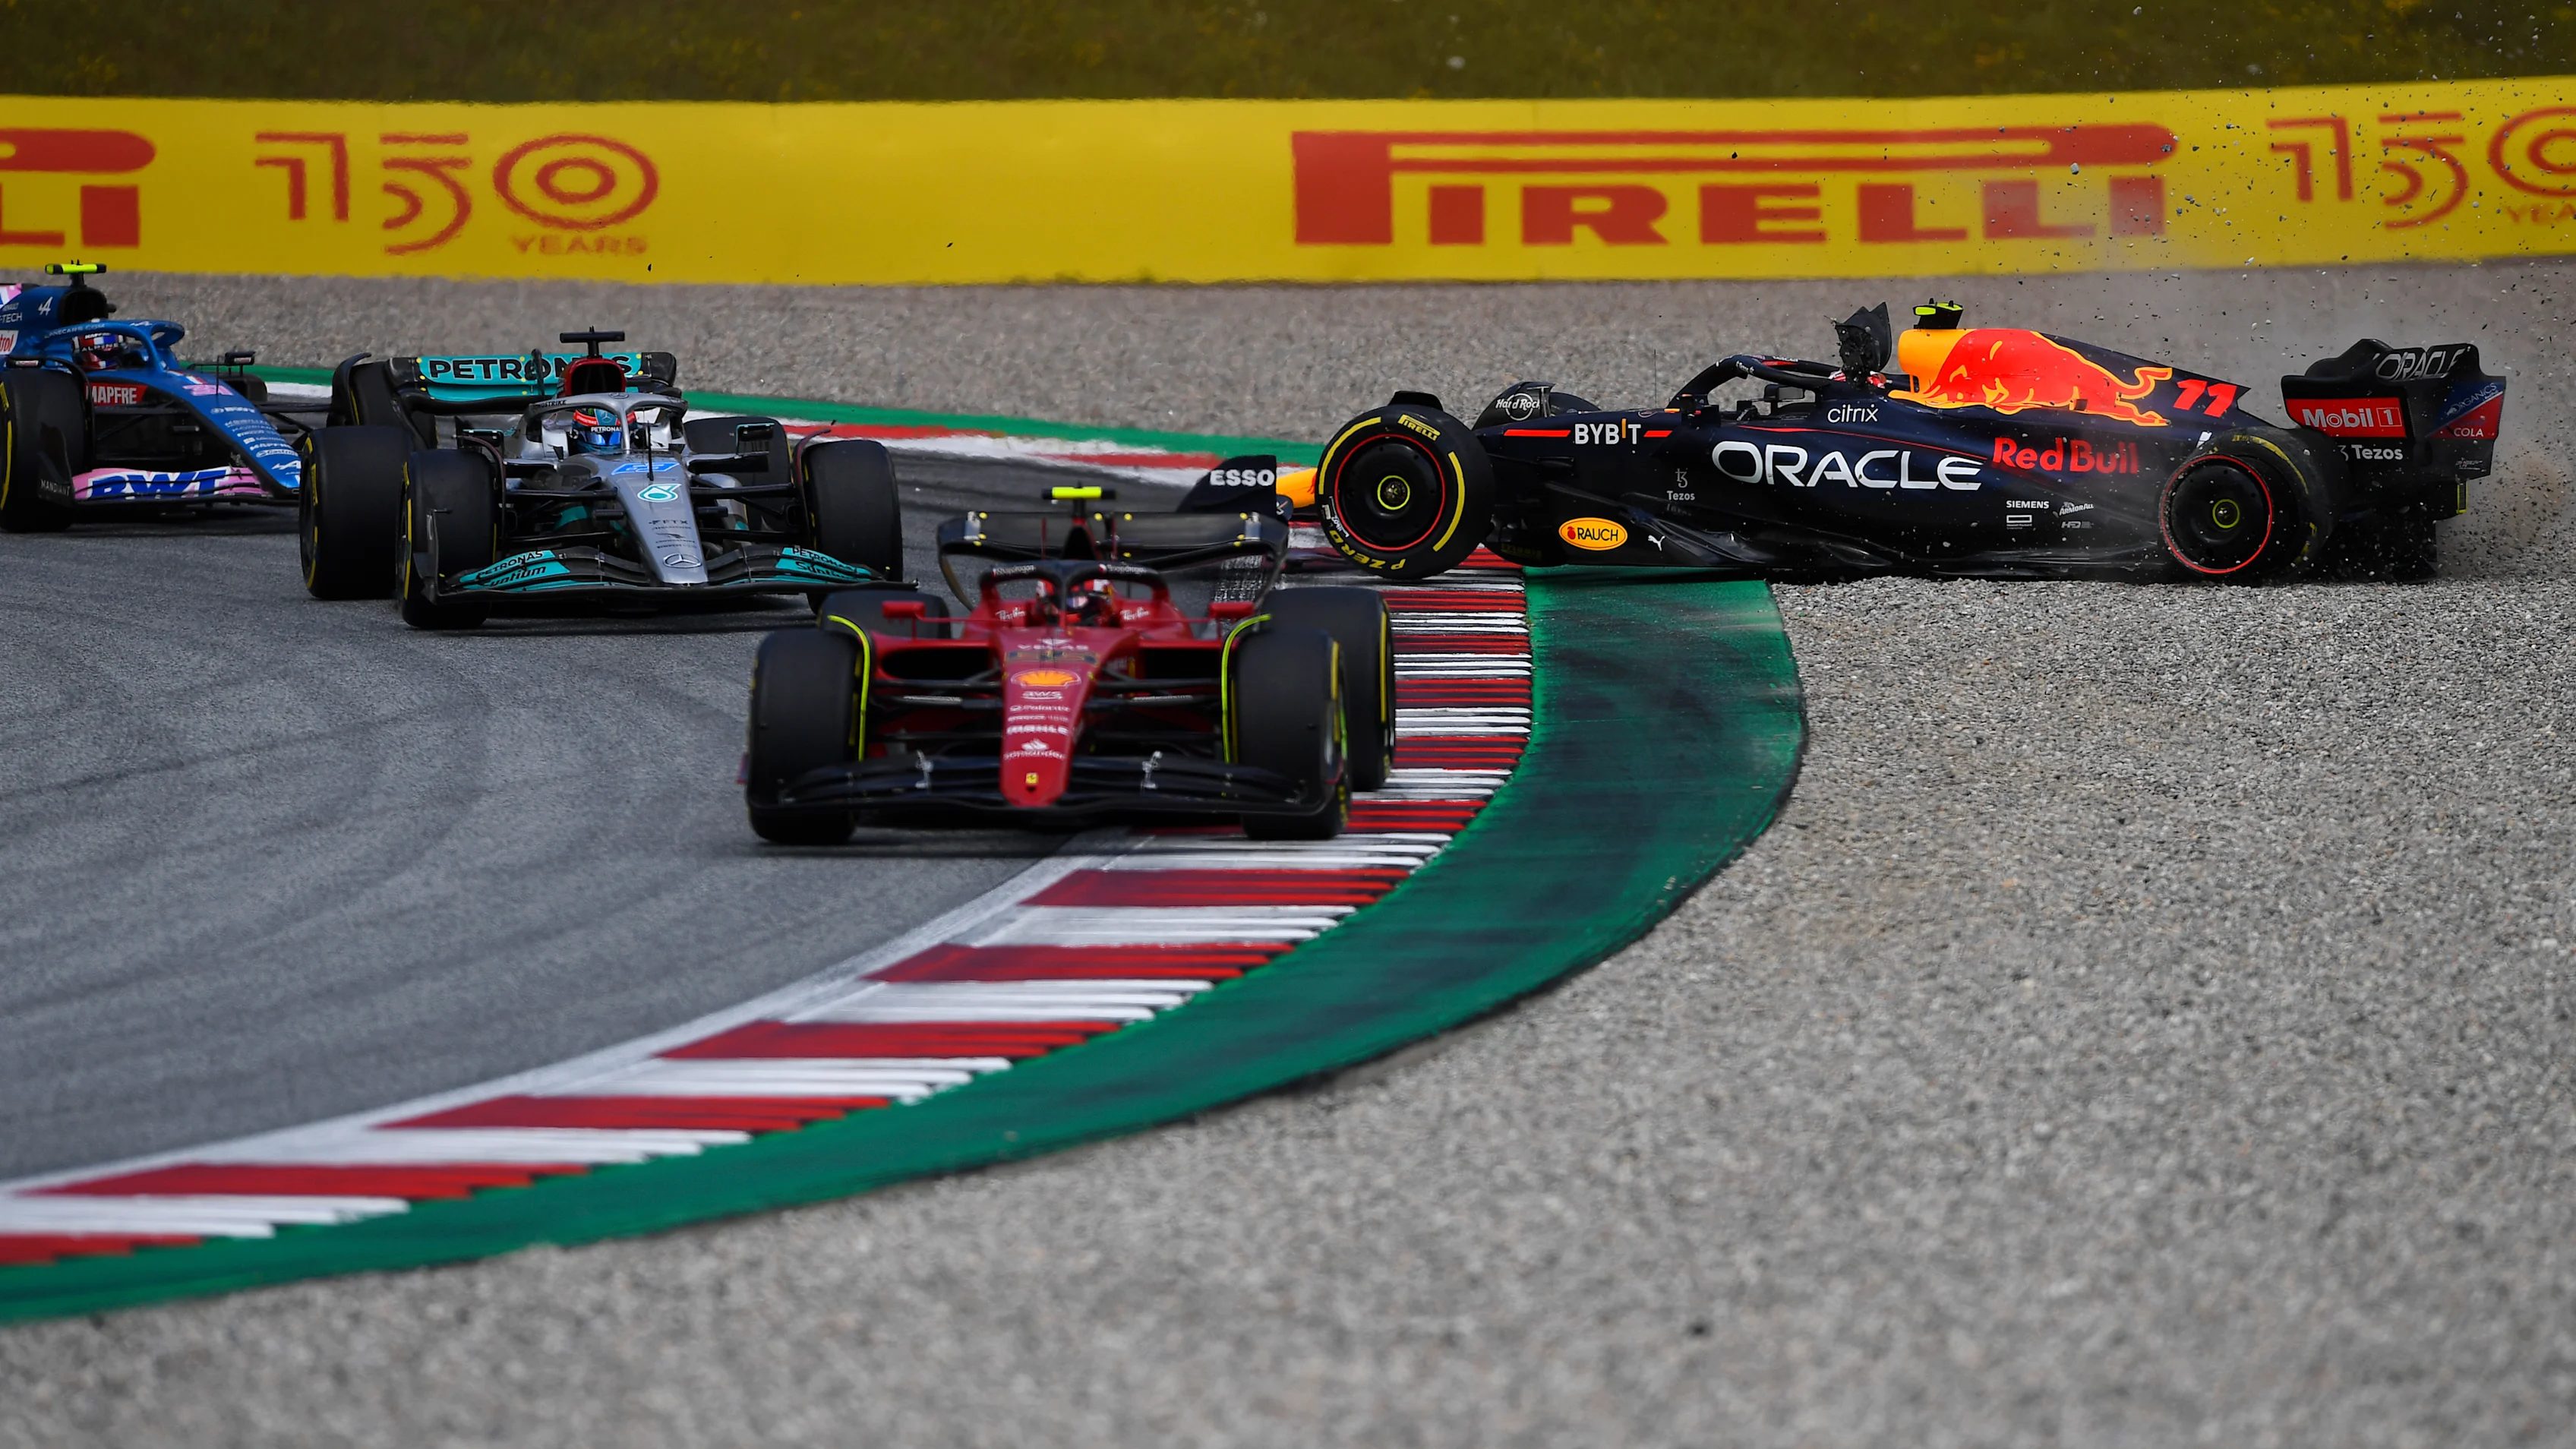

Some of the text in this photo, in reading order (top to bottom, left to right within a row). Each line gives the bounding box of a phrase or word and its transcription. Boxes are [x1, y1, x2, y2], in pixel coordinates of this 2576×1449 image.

[255, 132, 658, 255] 150
[1292, 122, 2177, 245] PIRELLI
[510, 235, 648, 256] YEARS
[428, 355, 633, 380] PETRONS
[2376, 348, 2467, 380] ORACLE
[1495, 398, 1540, 411] Hard Rock
[2173, 378, 2238, 418] 11
[1827, 404, 1880, 423] citrix
[2302, 408, 2374, 428] Mobil
[1397, 414, 1441, 442] PIRELLI
[1574, 418, 1642, 445] BYBIT
[2453, 428, 2484, 437] COLA
[1992, 436, 2139, 475] Red Bull
[2351, 444, 2404, 460] Tezos
[1712, 440, 1984, 491] ORACLE
[40, 478, 71, 497] MANDIANT
[86, 466, 231, 500] BWT
[1209, 469, 1276, 488] ESSO
[1666, 490, 1696, 501] Tezos
[2006, 500, 2050, 510] SIEMENS
[1577, 527, 1619, 542] RAUCH
[1330, 530, 1386, 570] ZERO
[475, 550, 544, 581] PETRONAS
